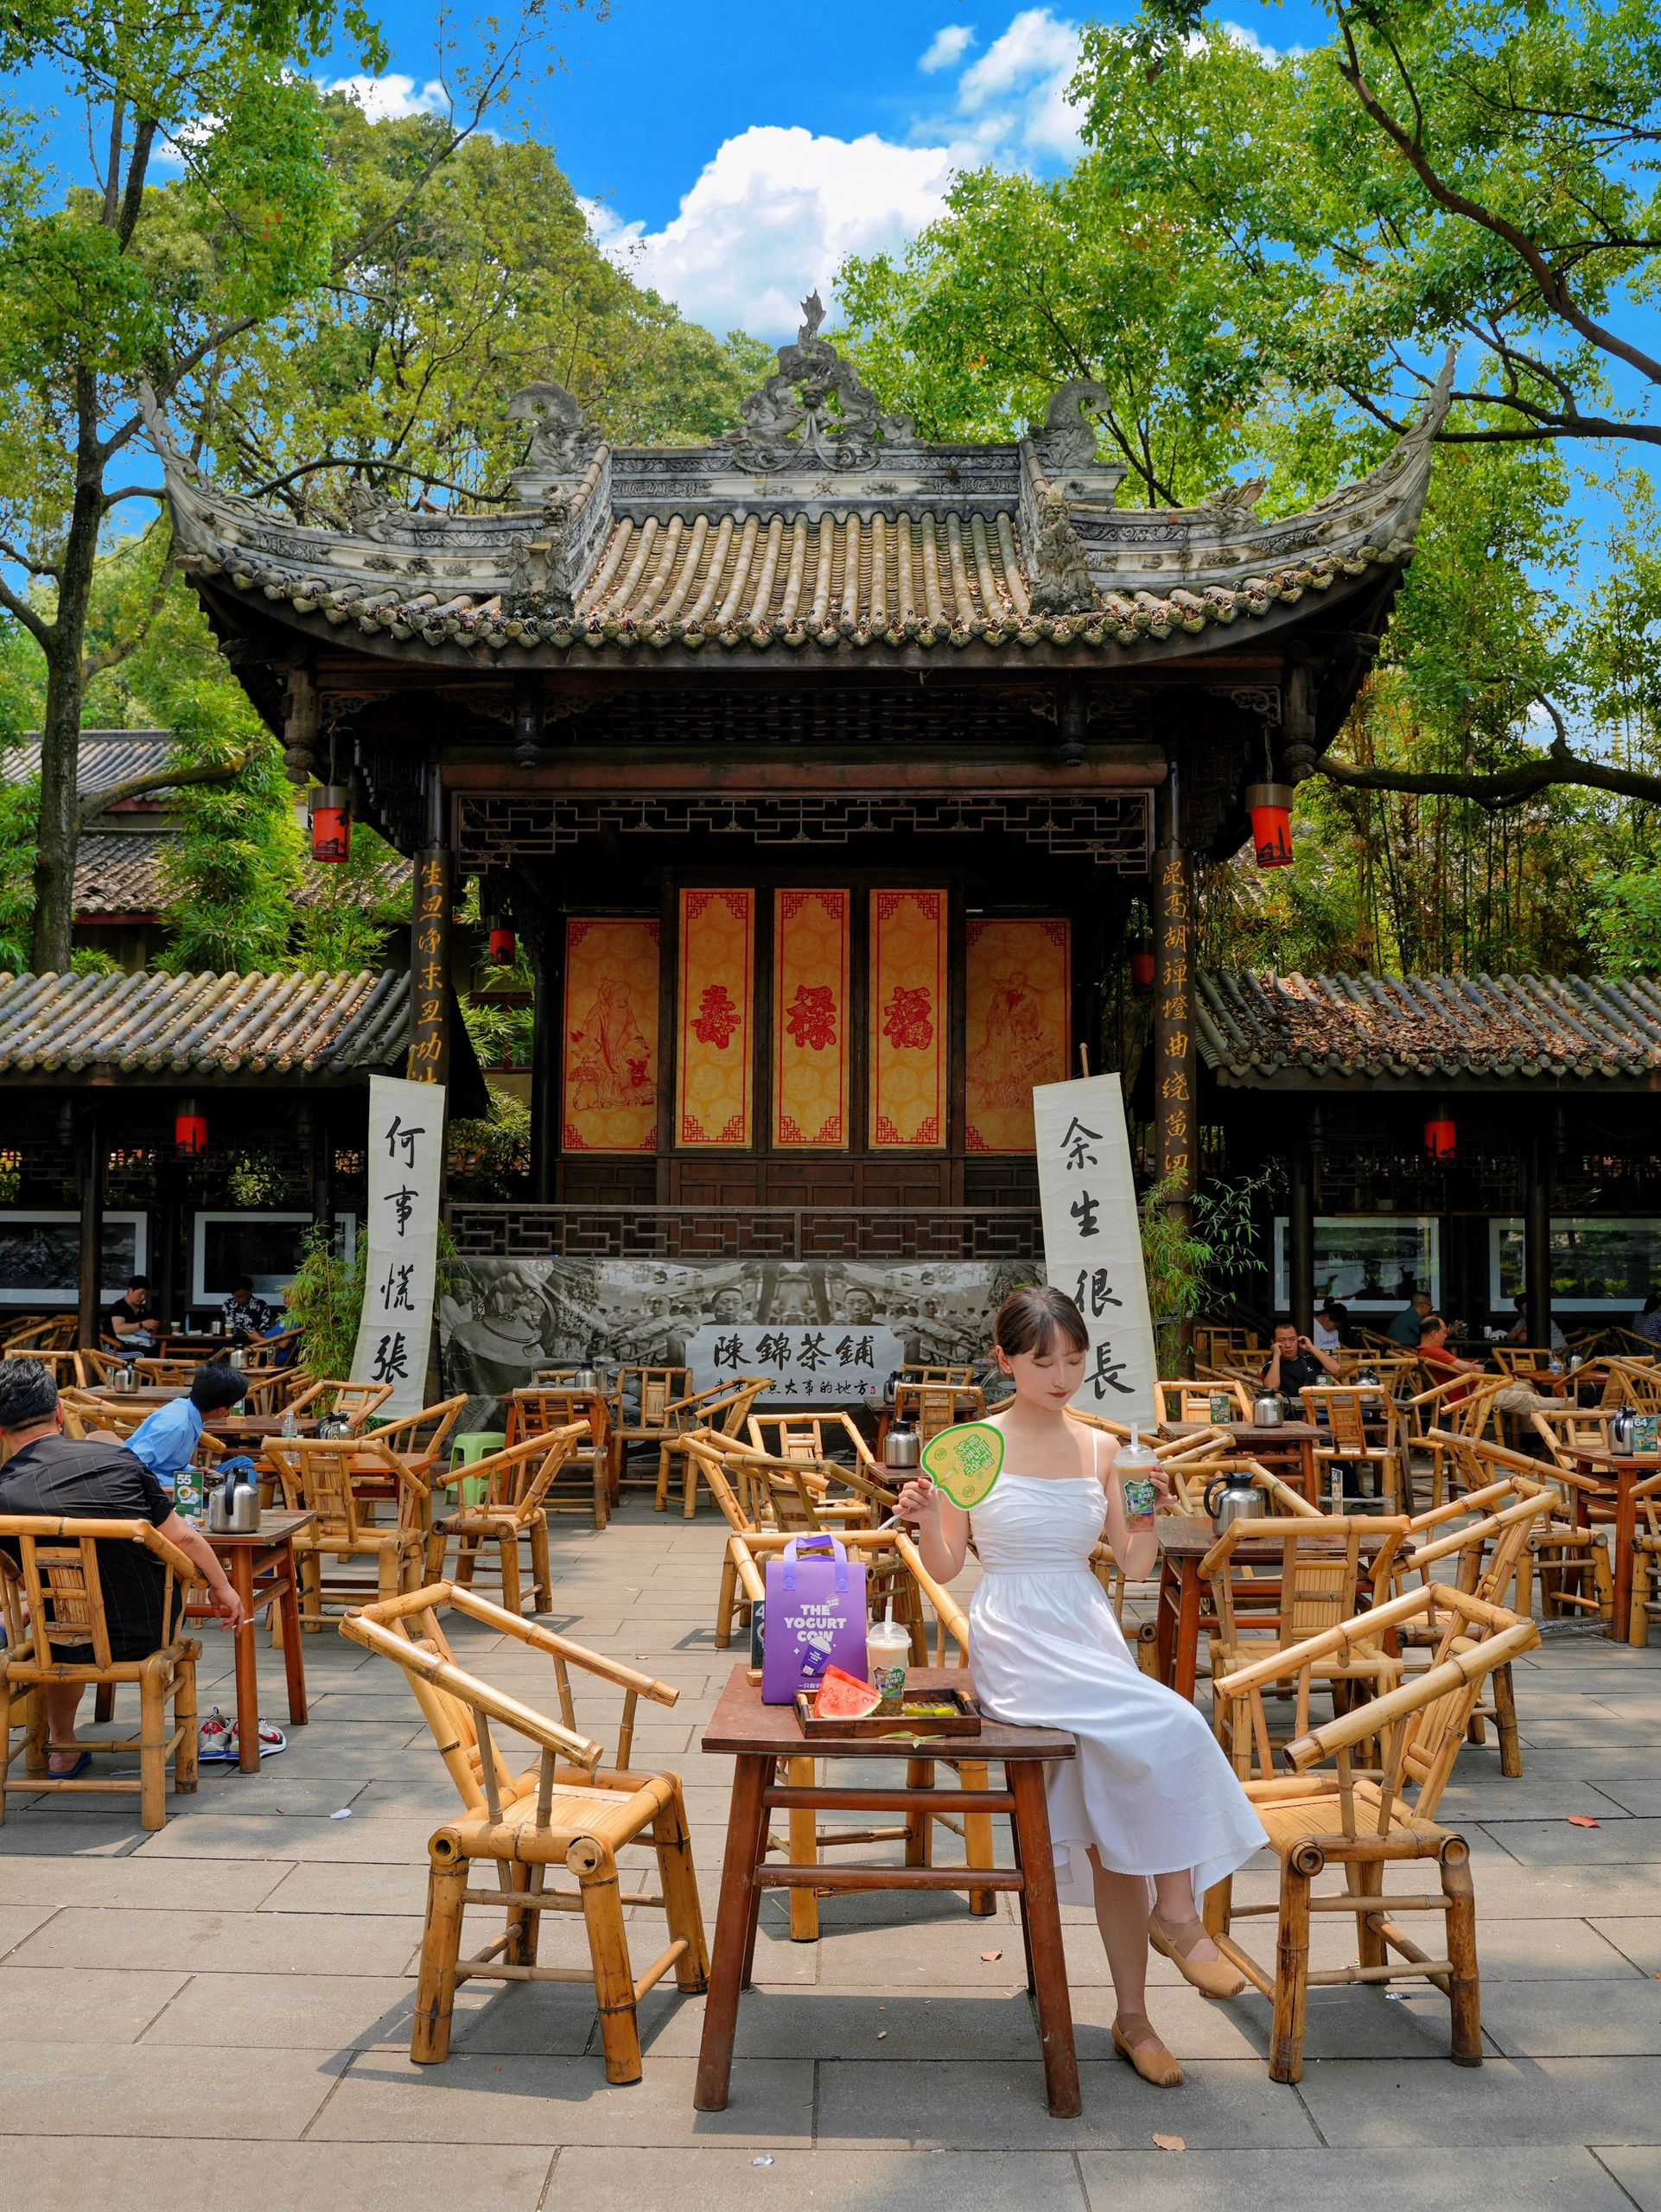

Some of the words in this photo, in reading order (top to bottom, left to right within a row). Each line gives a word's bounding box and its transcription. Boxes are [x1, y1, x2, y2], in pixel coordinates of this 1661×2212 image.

[882, 986, 934, 1051] 福
[1634, 1418, 1647, 1427] 64
[176, 1474, 192, 1484] 55
[800, 1604, 830, 1616] THE
[784, 1617, 847, 1630] YOGURT
